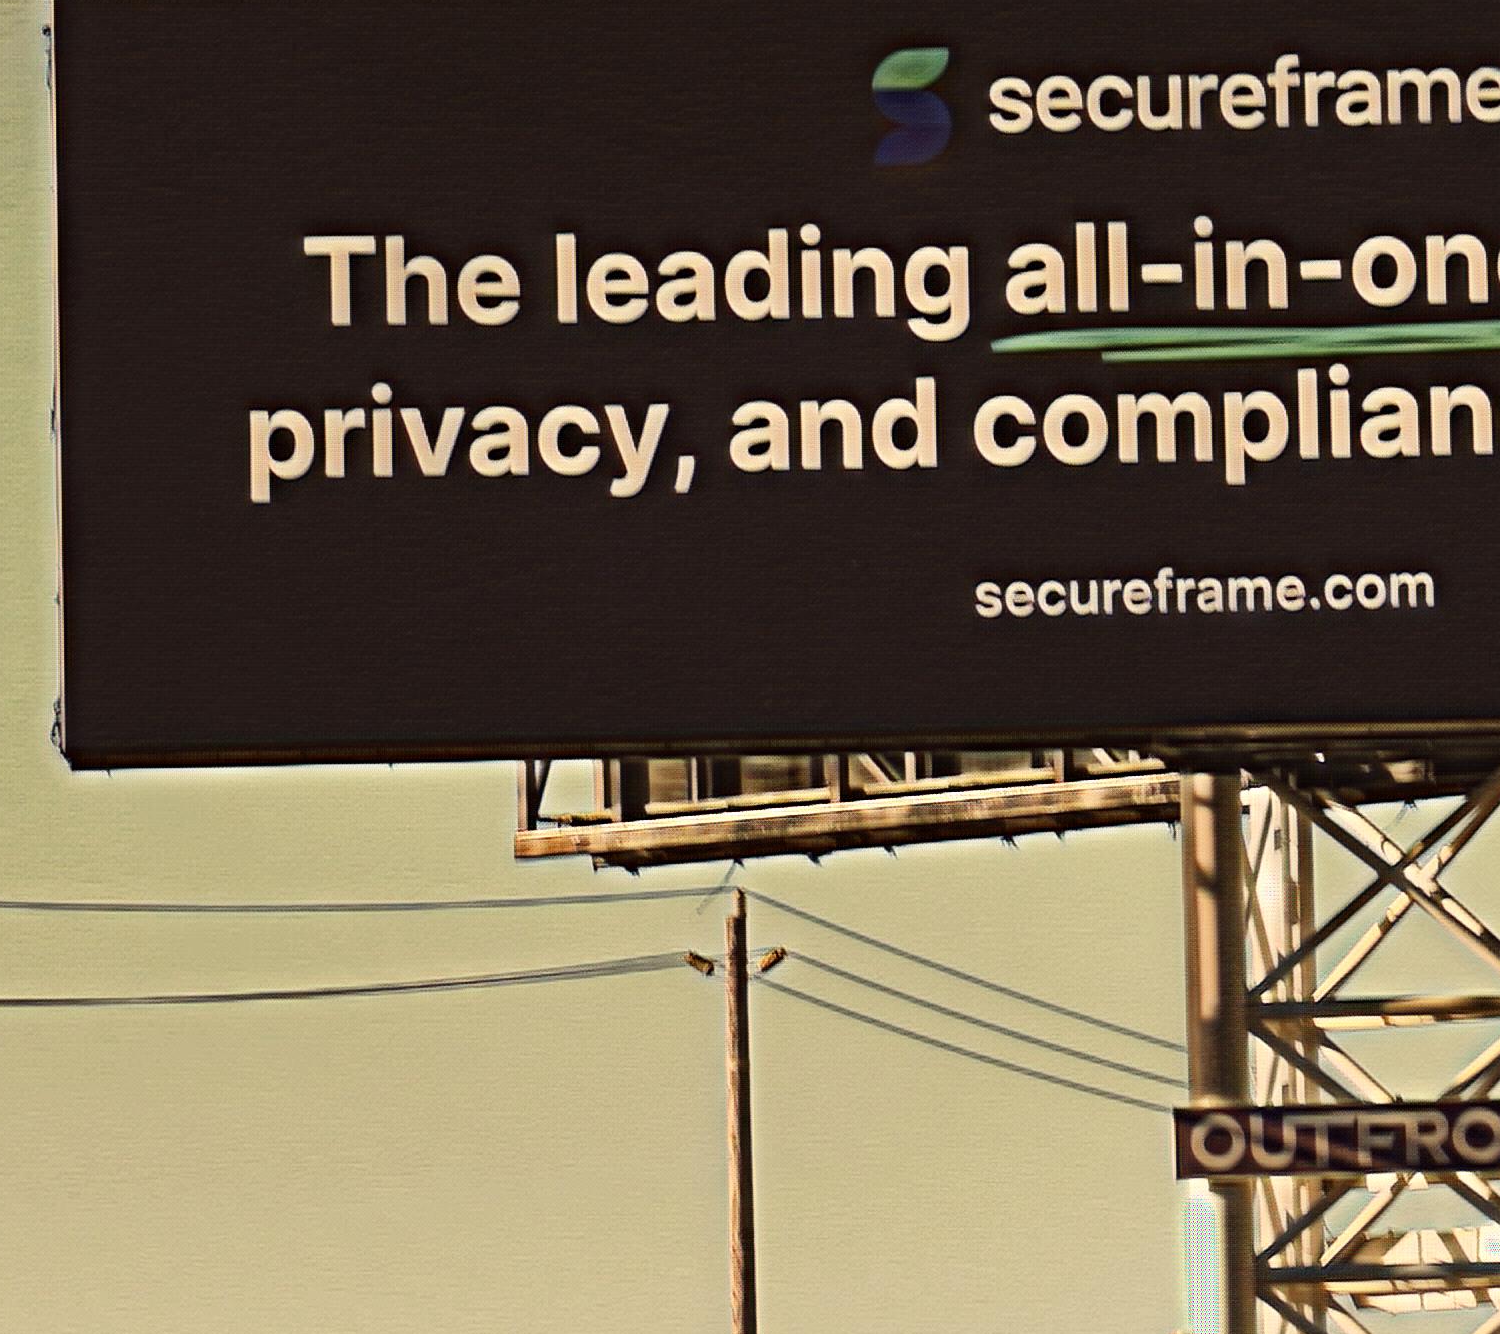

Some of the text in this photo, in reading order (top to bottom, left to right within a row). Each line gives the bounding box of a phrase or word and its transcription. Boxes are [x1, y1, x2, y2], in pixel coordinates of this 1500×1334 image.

[302, 233, 522, 327] The
[554, 222, 971, 343] leading
[248, 381, 696, 505] privacy,
[728, 375, 939, 473] and
[974, 565, 1436, 619] secureframe.com
